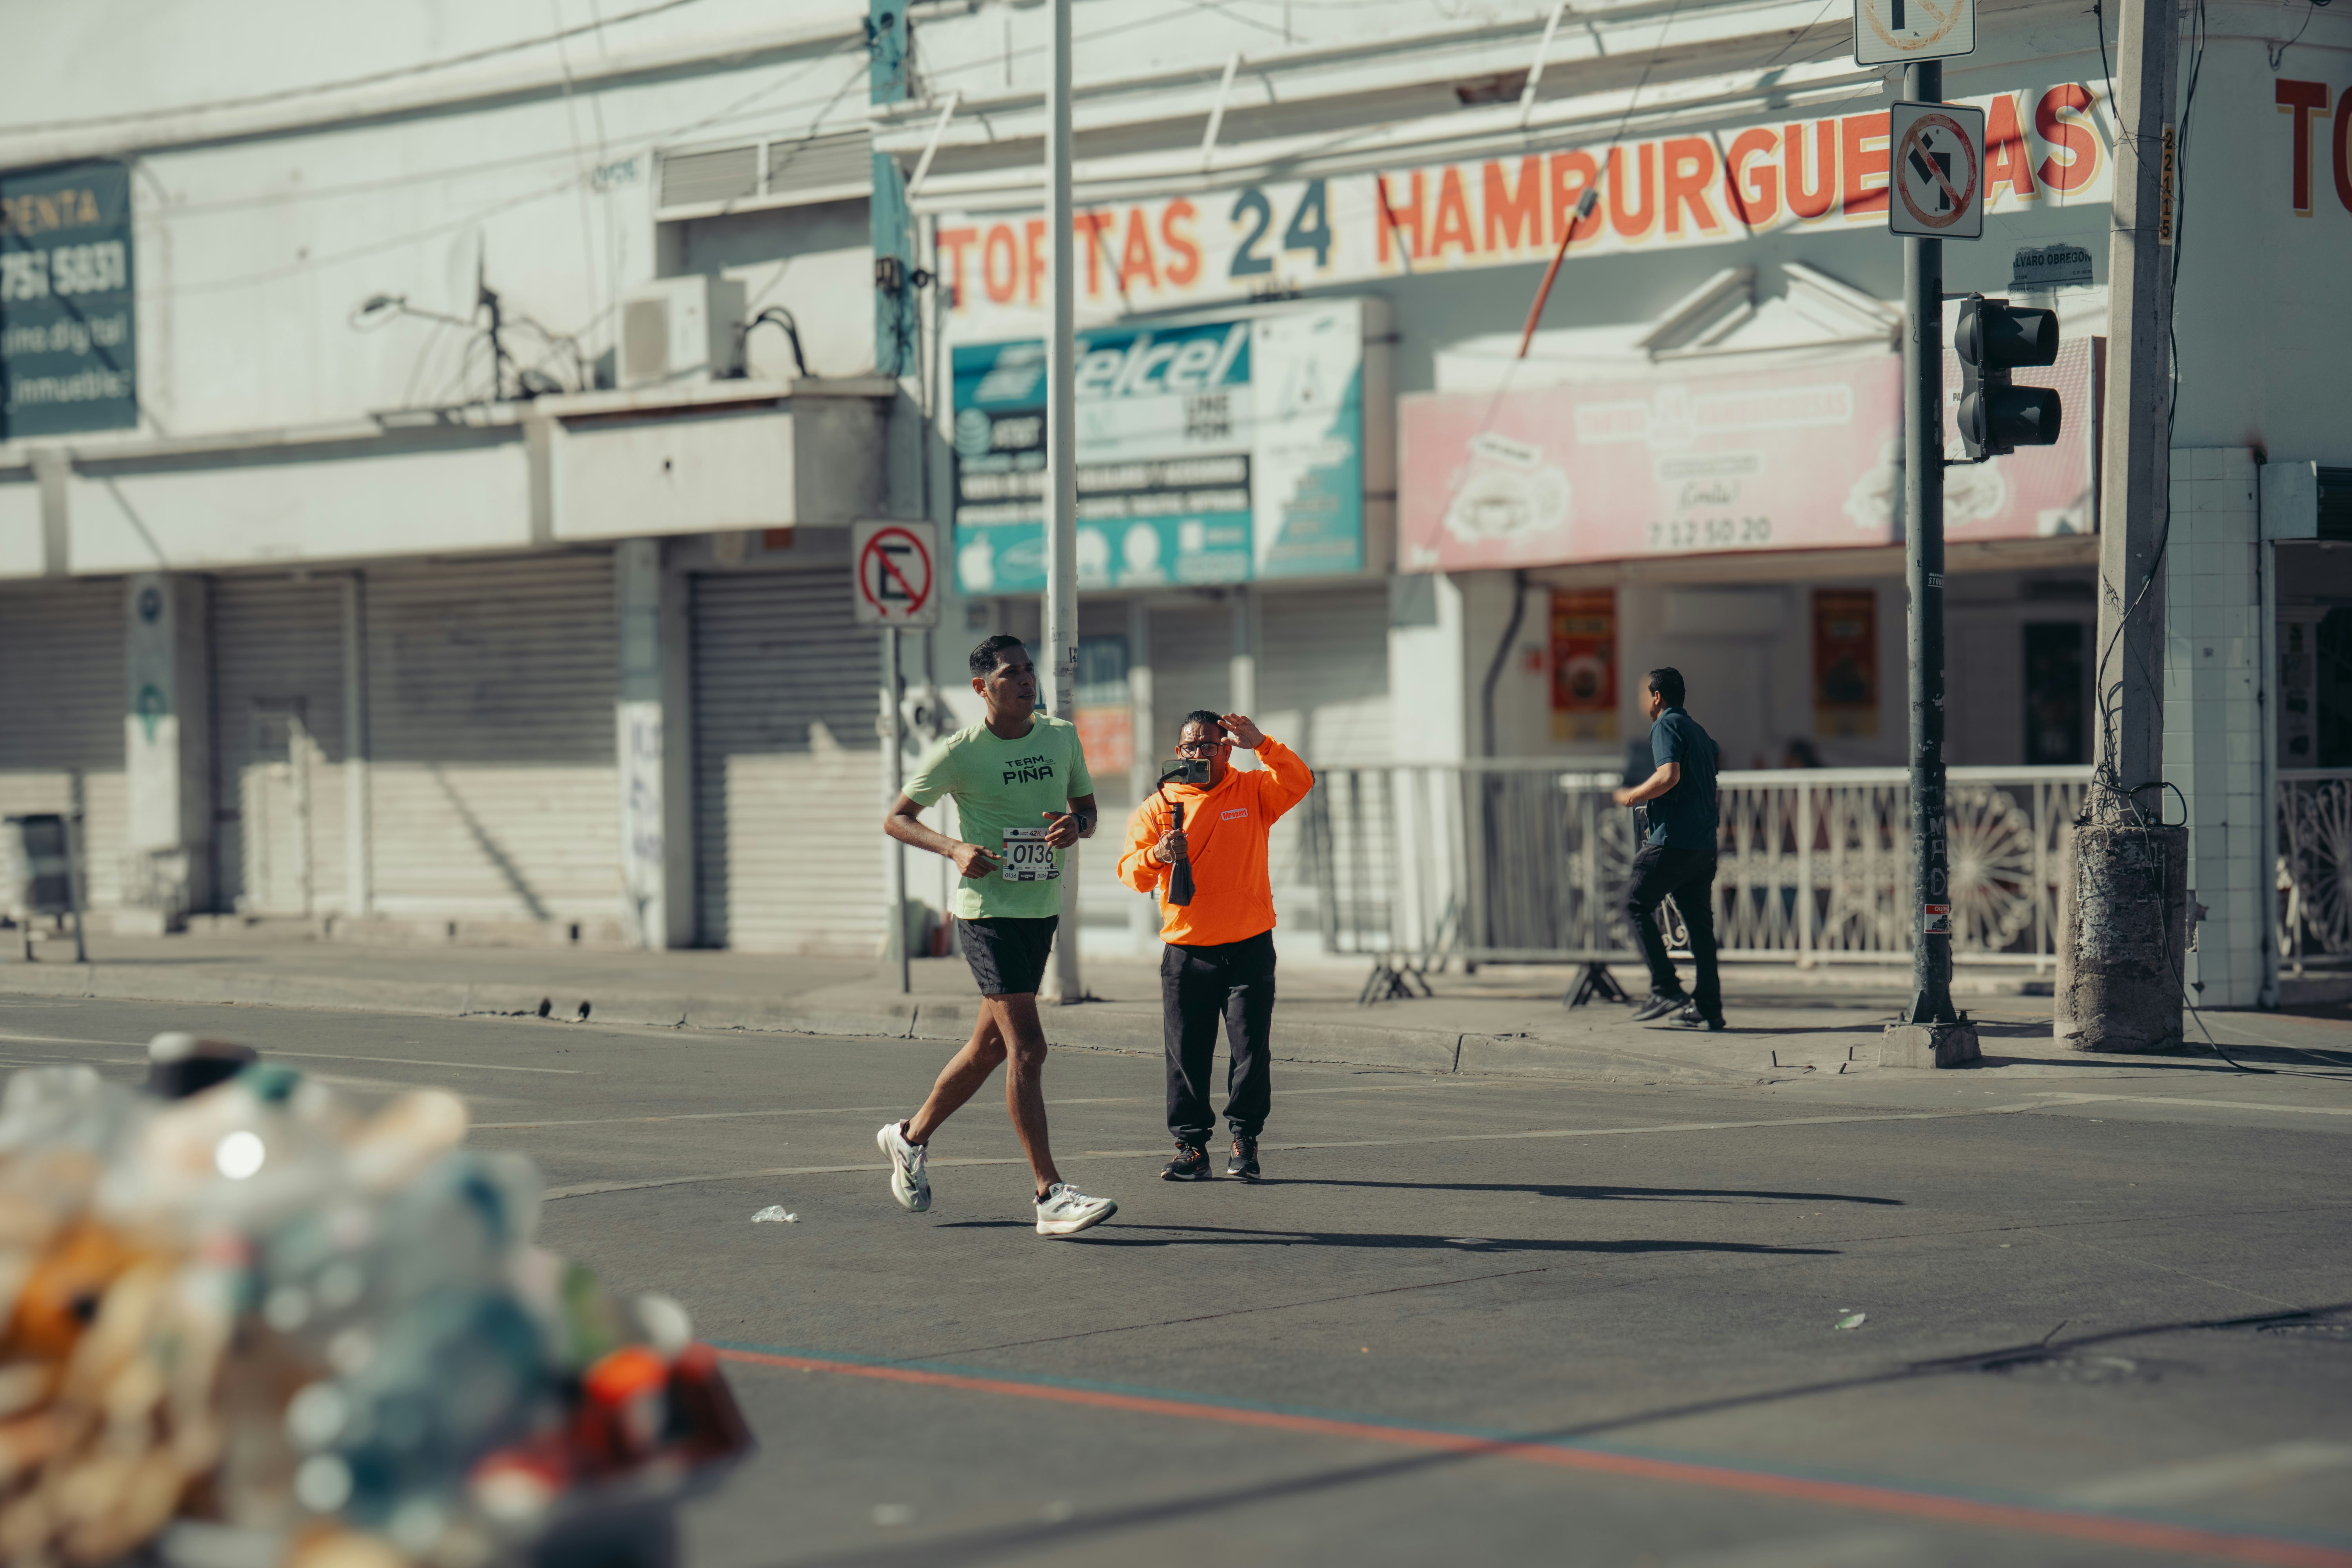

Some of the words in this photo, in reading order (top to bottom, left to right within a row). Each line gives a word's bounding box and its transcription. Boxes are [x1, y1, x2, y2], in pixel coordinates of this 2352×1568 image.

[1228, 179, 1334, 278] 24
[1377, 83, 2097, 264] HAMBURGUEAS
[2162, 131, 2173, 237] 22115
[2047, 251, 2091, 265] OBREGON
[1075, 321, 1249, 395] elcel
[1005, 755, 1045, 768] TEAM
[1002, 765, 1054, 785] PIÑA
[1223, 810, 1247, 819] Mrsport
[1013, 844, 1053, 864] 0136
